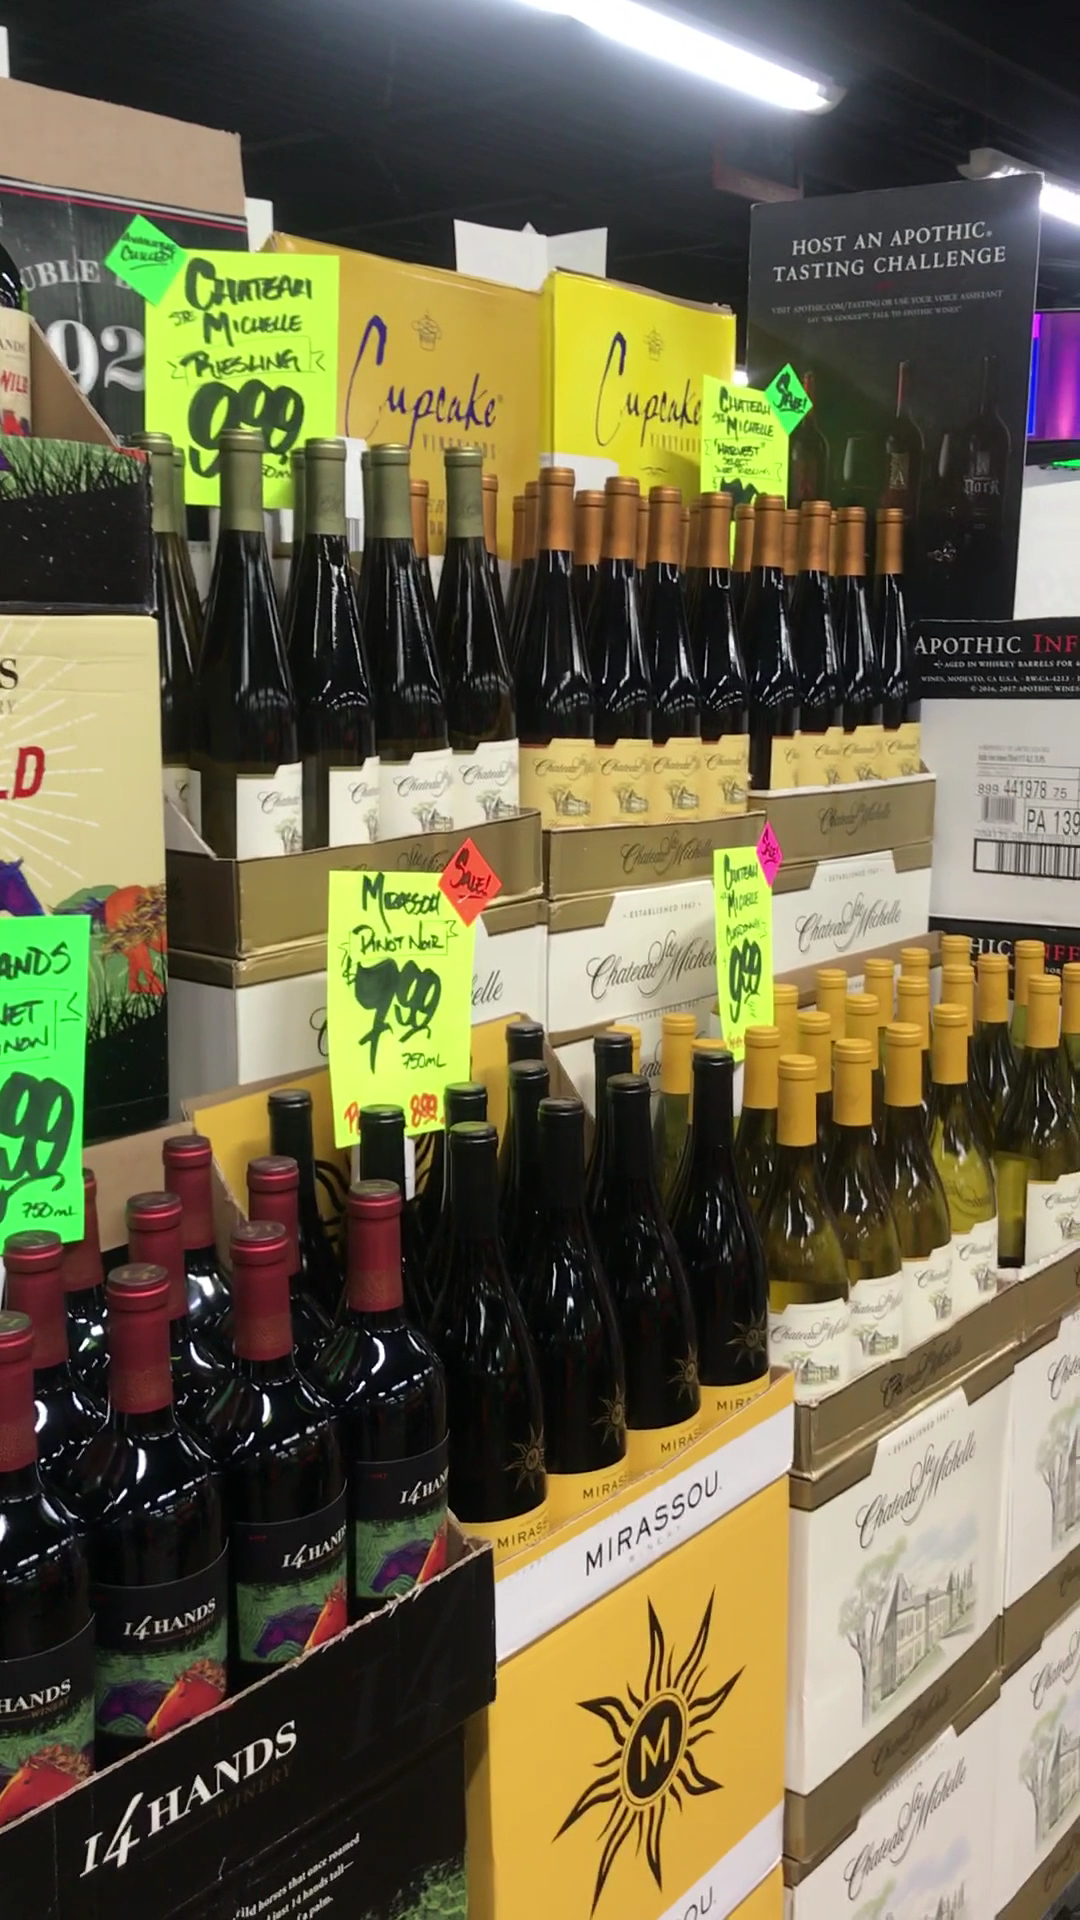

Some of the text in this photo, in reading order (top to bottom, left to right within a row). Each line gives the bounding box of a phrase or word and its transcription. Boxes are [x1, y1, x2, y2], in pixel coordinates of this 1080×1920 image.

[792, 235, 846, 256] HOST
[853, 232, 882, 250] AN
[773, 246, 1006, 283] TASTING CHALLENGE
[184, 257, 313, 311] CHATEAU
[771, 306, 791, 315] VISIT
[911, 295, 932, 304] YOUR
[934, 293, 958, 302] VOICE
[960, 289, 1004, 300] ASSISTANT
[203, 311, 303, 347] MICHELLE
[46, 319, 145, 396] 92
[345, 315, 497, 450] Cupcake
[914, 635, 1023, 656] APOTHIC
[944, 660, 1073, 669] AGED IN WHISKEY BARRELS FOR
[1019, 685, 1054, 693] APOTHIC
[1004, 779, 1047, 799] 441978
[1053, 787, 1068, 799] 75
[1027, 809, 1047, 833] PA
[451, 848, 492, 897] SALE!
[621, 842, 666, 874] Chateau
[629, 905, 678, 919] ESTABLISHED
[795, 912, 851, 953] Chateau
[856, 899, 902, 939] Michelle
[352, 920, 444, 956] PINOT NOIR
[0, 941, 71, 976] ANDS
[586, 954, 658, 1001] Chateau
[850, 1300, 883, 1316] hateau
[769, 1324, 818, 1344] Chateau
[660, 1428, 702, 1454] MIRAS
[400, 1465, 449, 1506] 14 HAN
[855, 1491, 920, 1549] Chateau
[928, 1430, 977, 1503] Michelle
[497, 1517, 549, 1550] MIRASS
[585, 1470, 719, 1577] MIRASSOU
[281, 1543, 308, 1570] 14
[124, 1597, 217, 1641] 14 HANDS
[79, 1719, 298, 1878] 14 HANDS
[843, 1840, 906, 1901] Chateau
[915, 1756, 967, 1836] Michelle
[258, 1886, 288, 1913] horses
[288, 1872, 306, 1891] that
[307, 1857, 328, 1878] once
[328, 1831, 361, 1863] roamed
[291, 1894, 302, 1909] 14
[302, 1876, 329, 1901] hands
